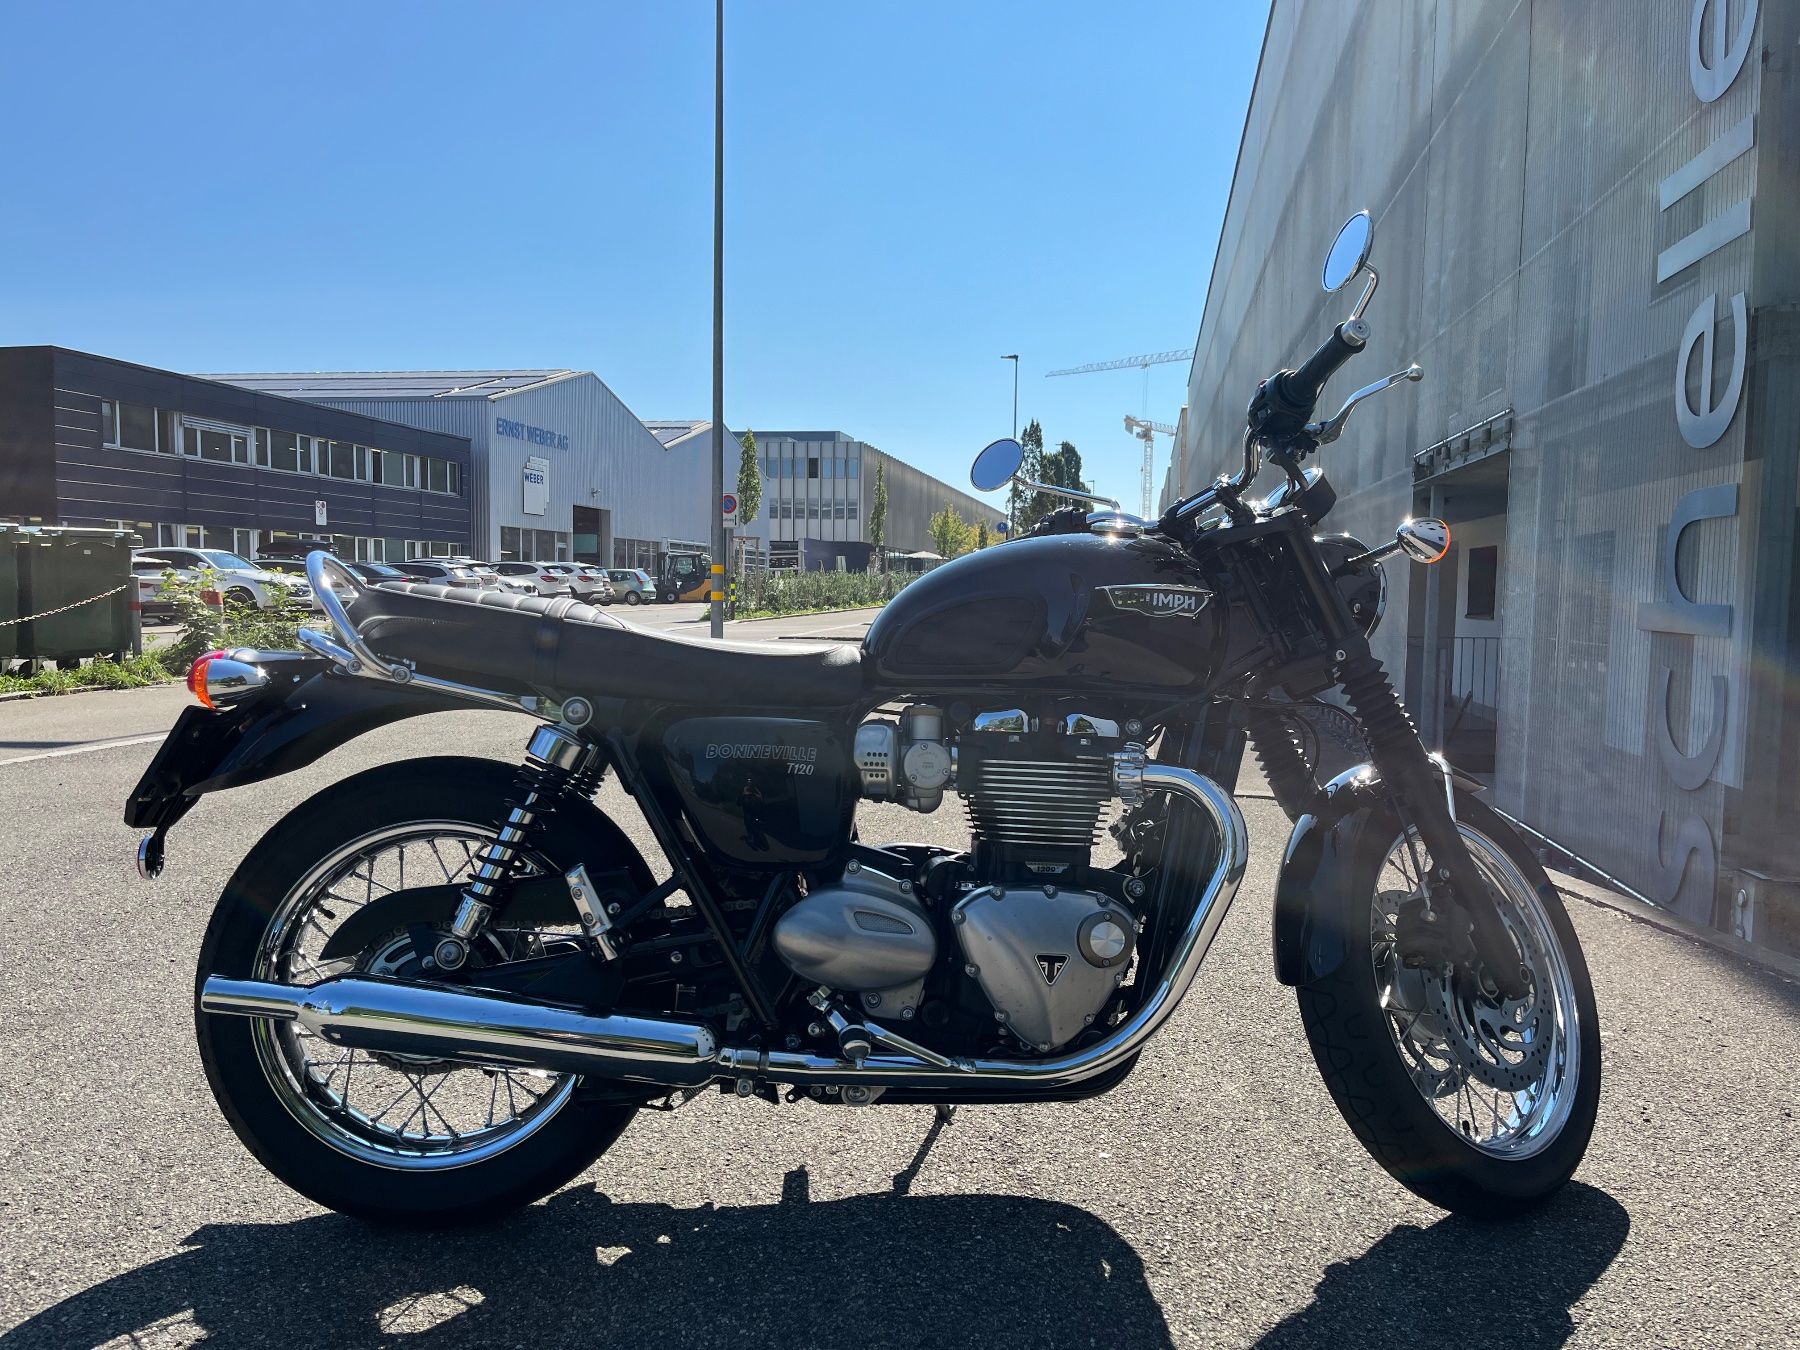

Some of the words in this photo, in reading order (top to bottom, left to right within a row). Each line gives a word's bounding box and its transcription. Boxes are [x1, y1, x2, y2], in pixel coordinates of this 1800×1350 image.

[496, 417, 526, 440] ERNST
[527, 424, 557, 449] WEBER
[556, 433, 569, 452] AG
[524, 472, 544, 485] WEBER
[1114, 590, 1196, 611] UMPH
[705, 743, 818, 762] BONNEVILLE
[786, 762, 814, 776] T120
